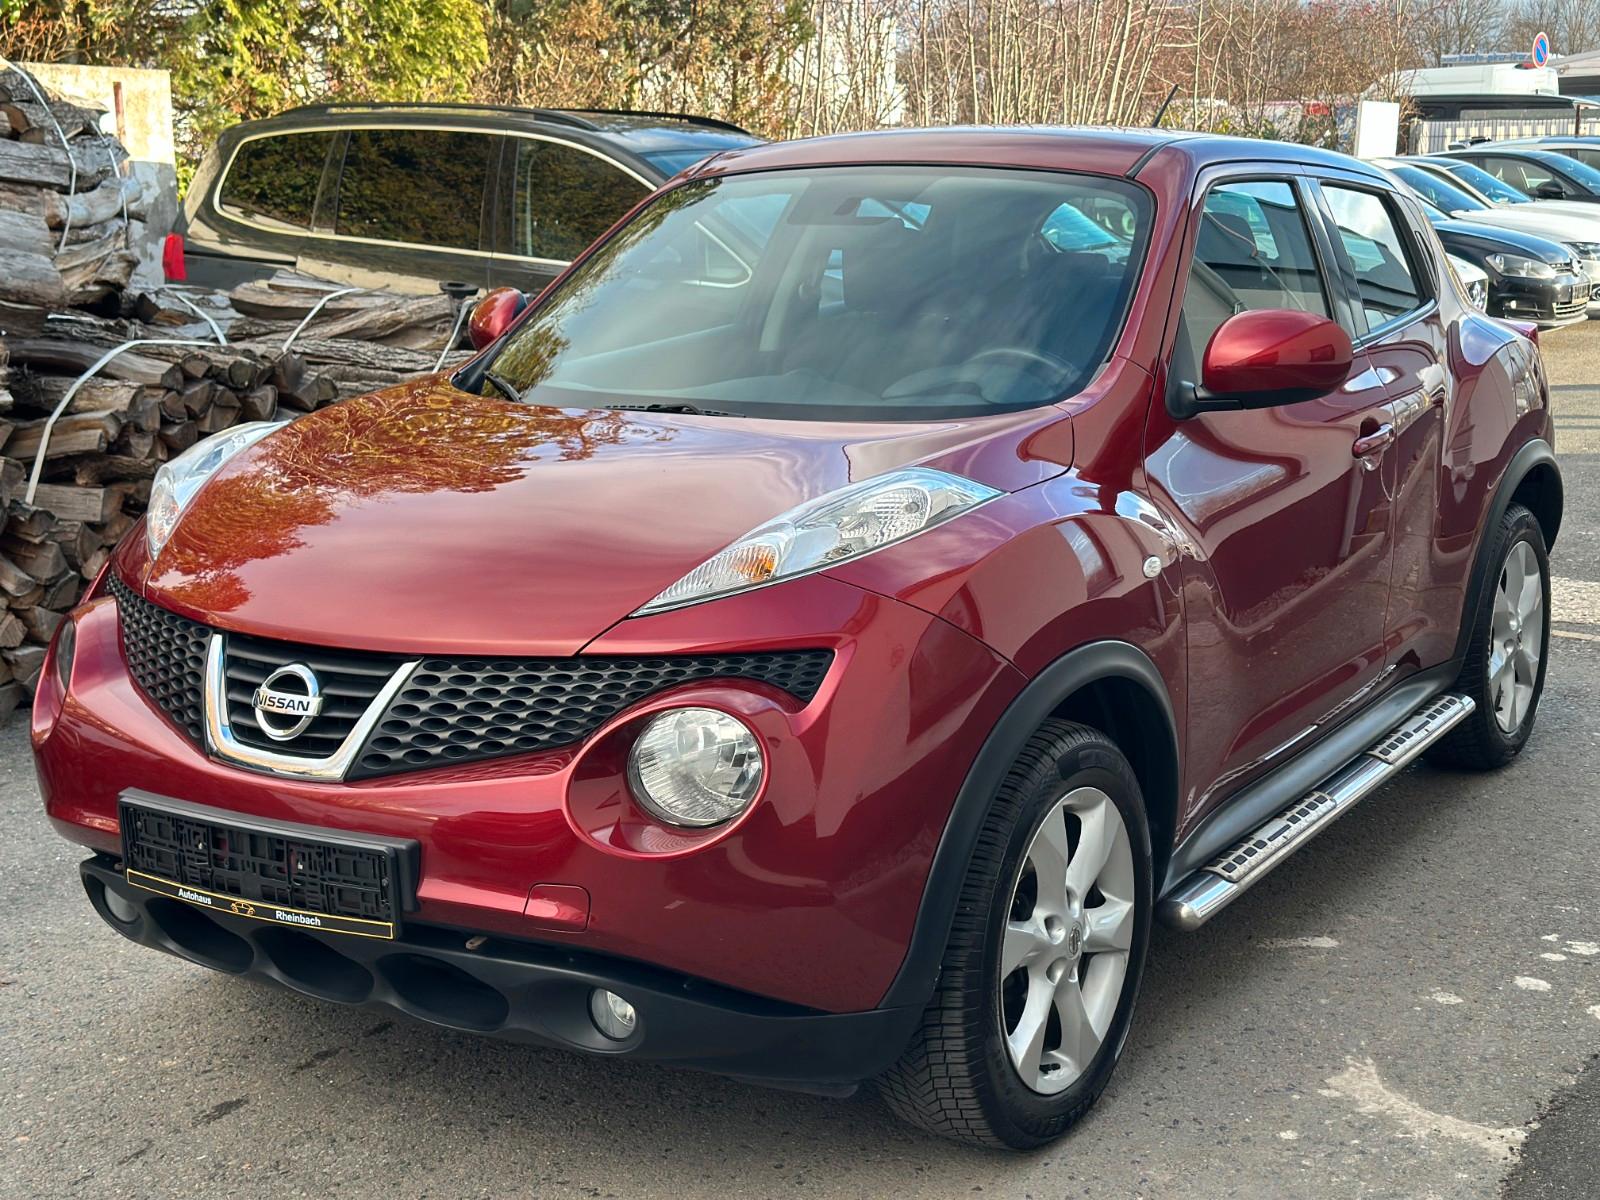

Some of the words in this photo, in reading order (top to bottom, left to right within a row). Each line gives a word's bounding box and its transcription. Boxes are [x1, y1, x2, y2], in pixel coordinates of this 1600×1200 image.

[255, 692, 310, 712] NISSAN
[178, 888, 212, 905] Autohaus
[275, 910, 321, 926] Rheinbach
